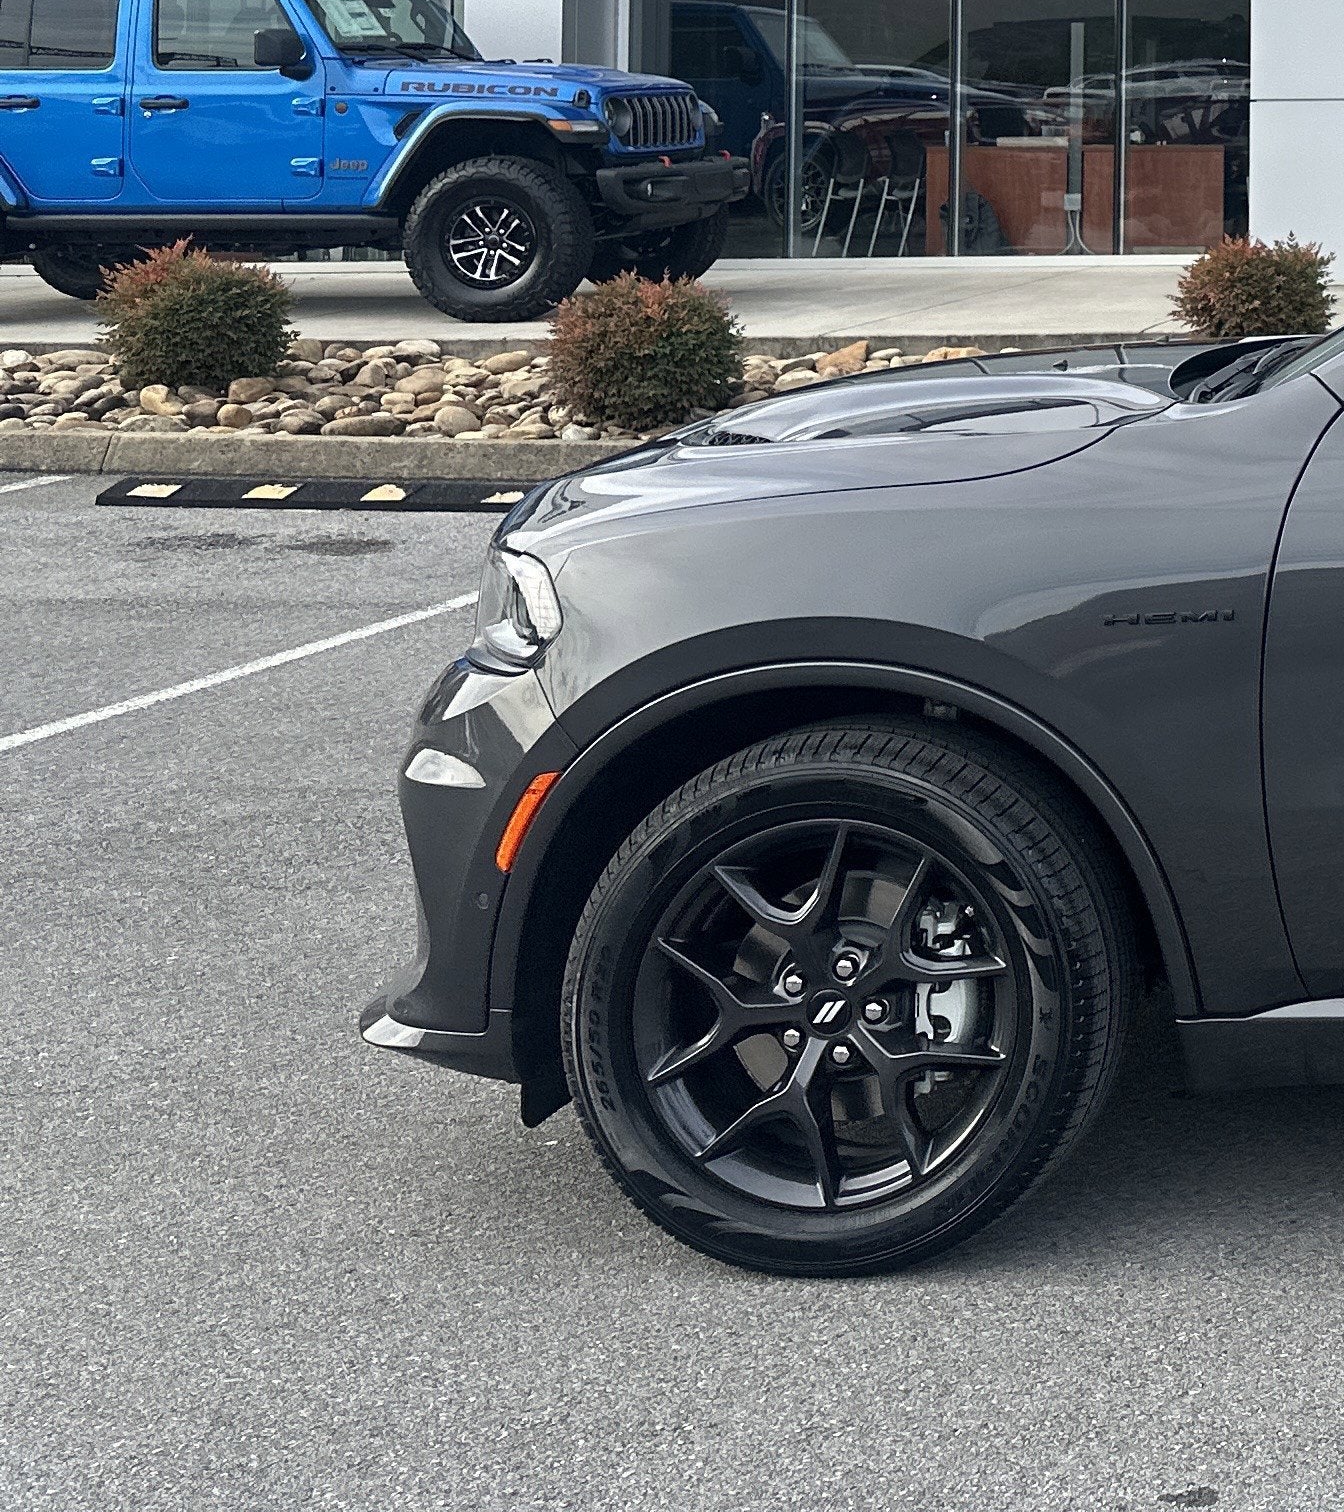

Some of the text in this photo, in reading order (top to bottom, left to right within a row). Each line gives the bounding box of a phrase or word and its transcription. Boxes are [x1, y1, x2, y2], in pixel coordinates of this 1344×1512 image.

[401, 80, 559, 97] RUBICON
[330, 158, 368, 171] Jeep
[1104, 609, 1235, 626] HEMI
